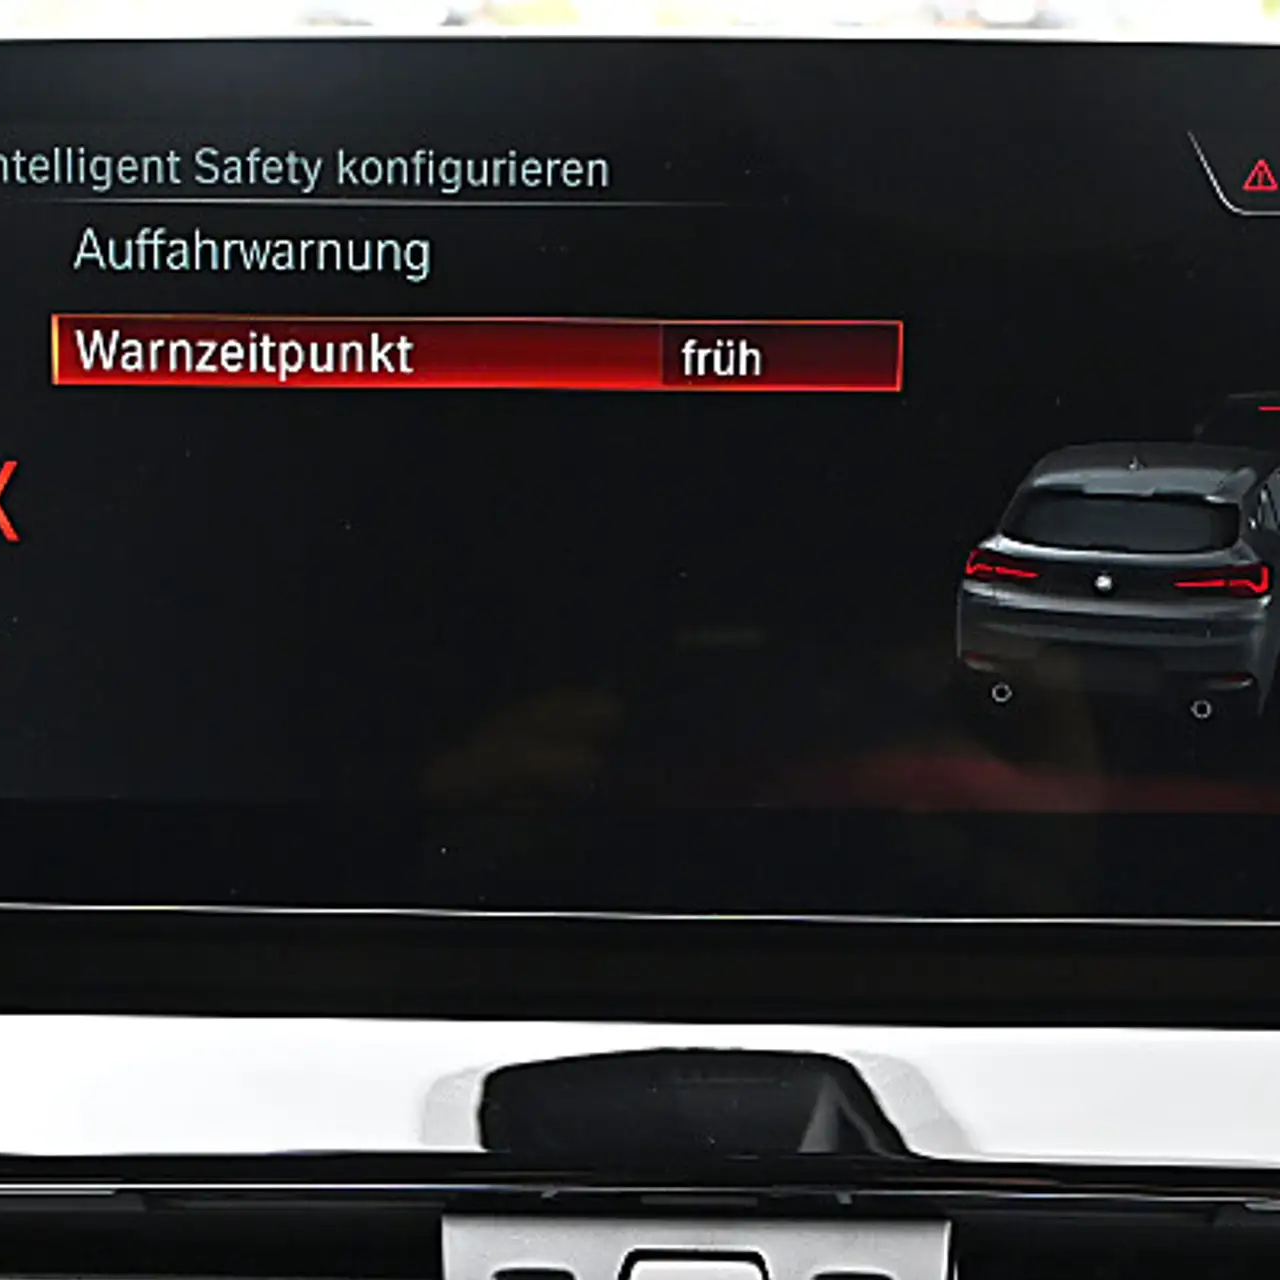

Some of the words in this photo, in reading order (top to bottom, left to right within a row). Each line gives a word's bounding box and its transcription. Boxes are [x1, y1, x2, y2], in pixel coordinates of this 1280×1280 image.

[196, 148, 321, 193] Safety
[339, 150, 607, 193] konfigurieren
[74, 228, 429, 282] Auffahrwarnung
[74, 329, 415, 382] Warnzeitpunkt
[682, 339, 760, 375] früh
